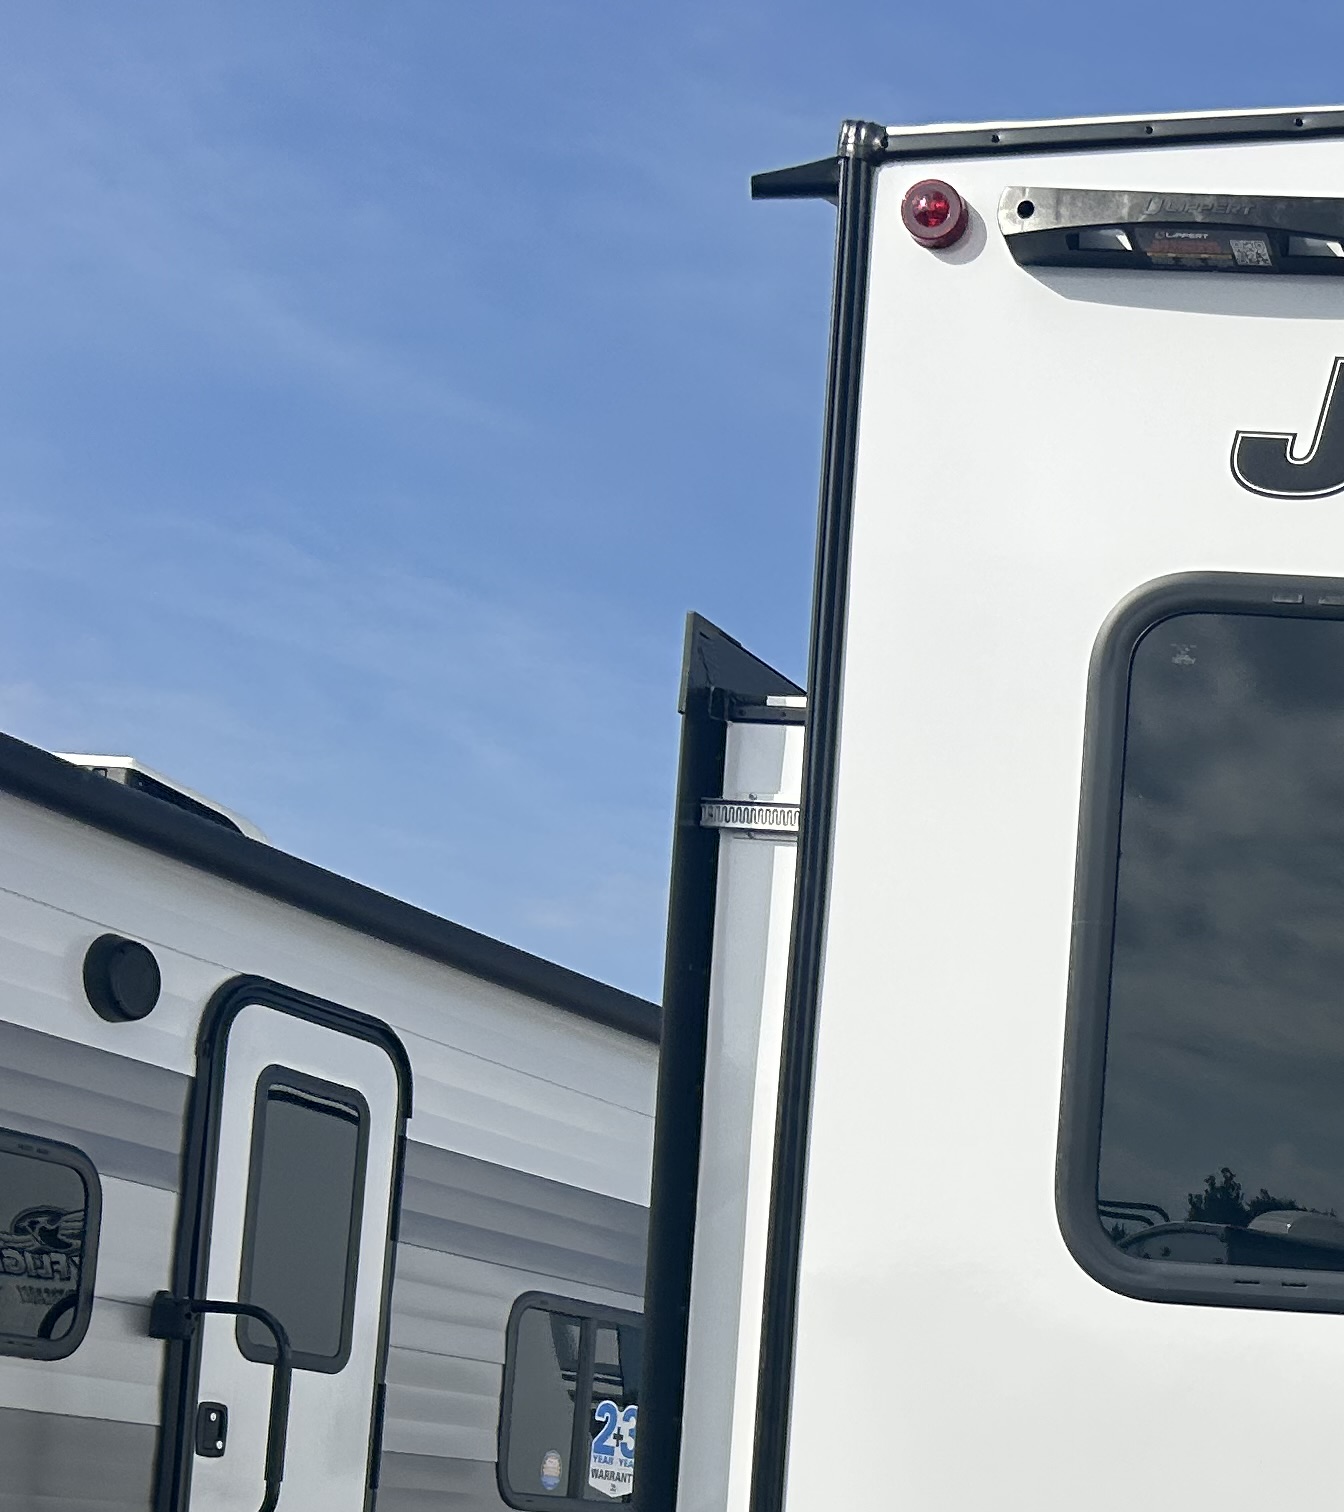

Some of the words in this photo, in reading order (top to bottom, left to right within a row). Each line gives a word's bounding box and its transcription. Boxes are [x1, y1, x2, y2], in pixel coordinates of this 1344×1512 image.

[1163, 199, 1255, 215] LIPPERT
[618, 1458, 634, 1467] YEA
[591, 1468, 633, 1484] WARRANT
